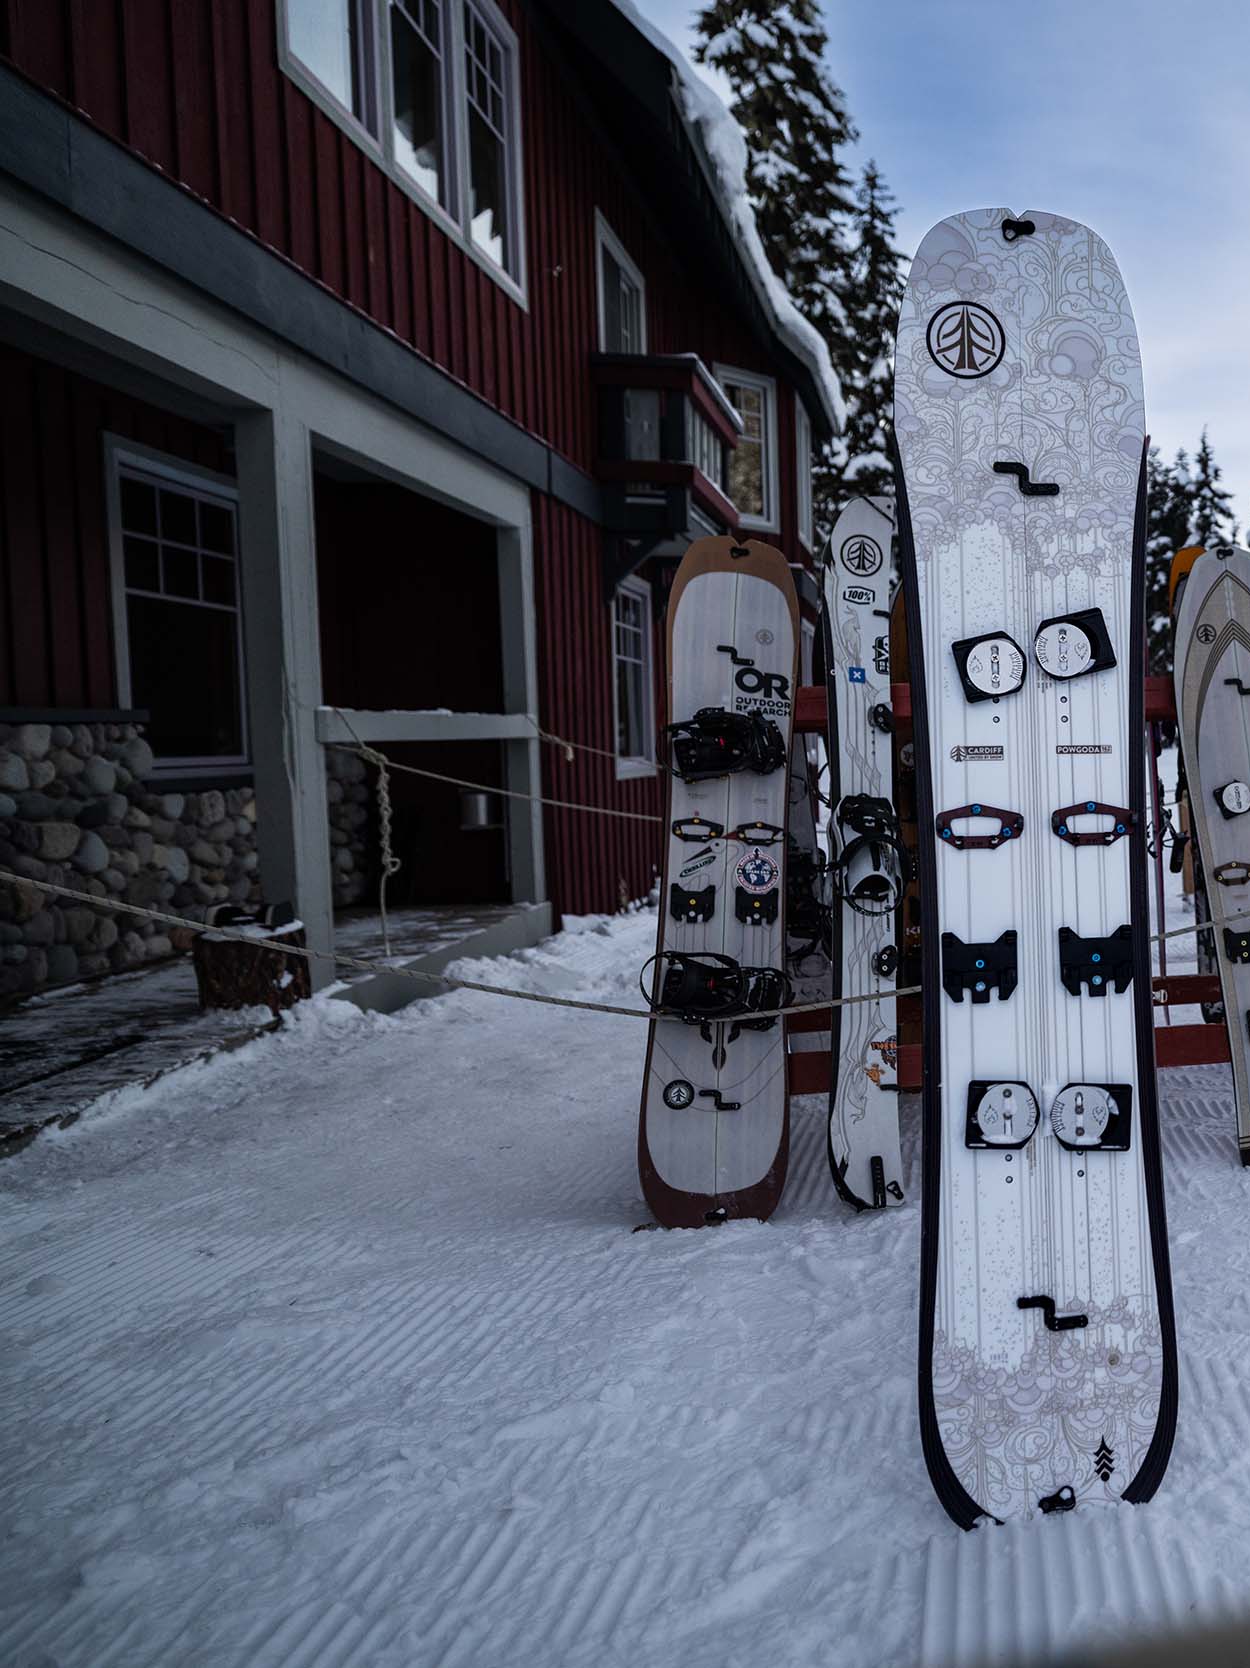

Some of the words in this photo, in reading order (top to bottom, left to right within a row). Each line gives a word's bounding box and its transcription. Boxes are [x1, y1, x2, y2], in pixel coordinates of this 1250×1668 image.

[848, 590, 871, 602] 100%
[735, 667, 791, 701] OR
[736, 697, 791, 709] OUTDOOR
[967, 747, 1003, 755] CARDIFF
[1057, 746, 1100, 754] POWGODA
